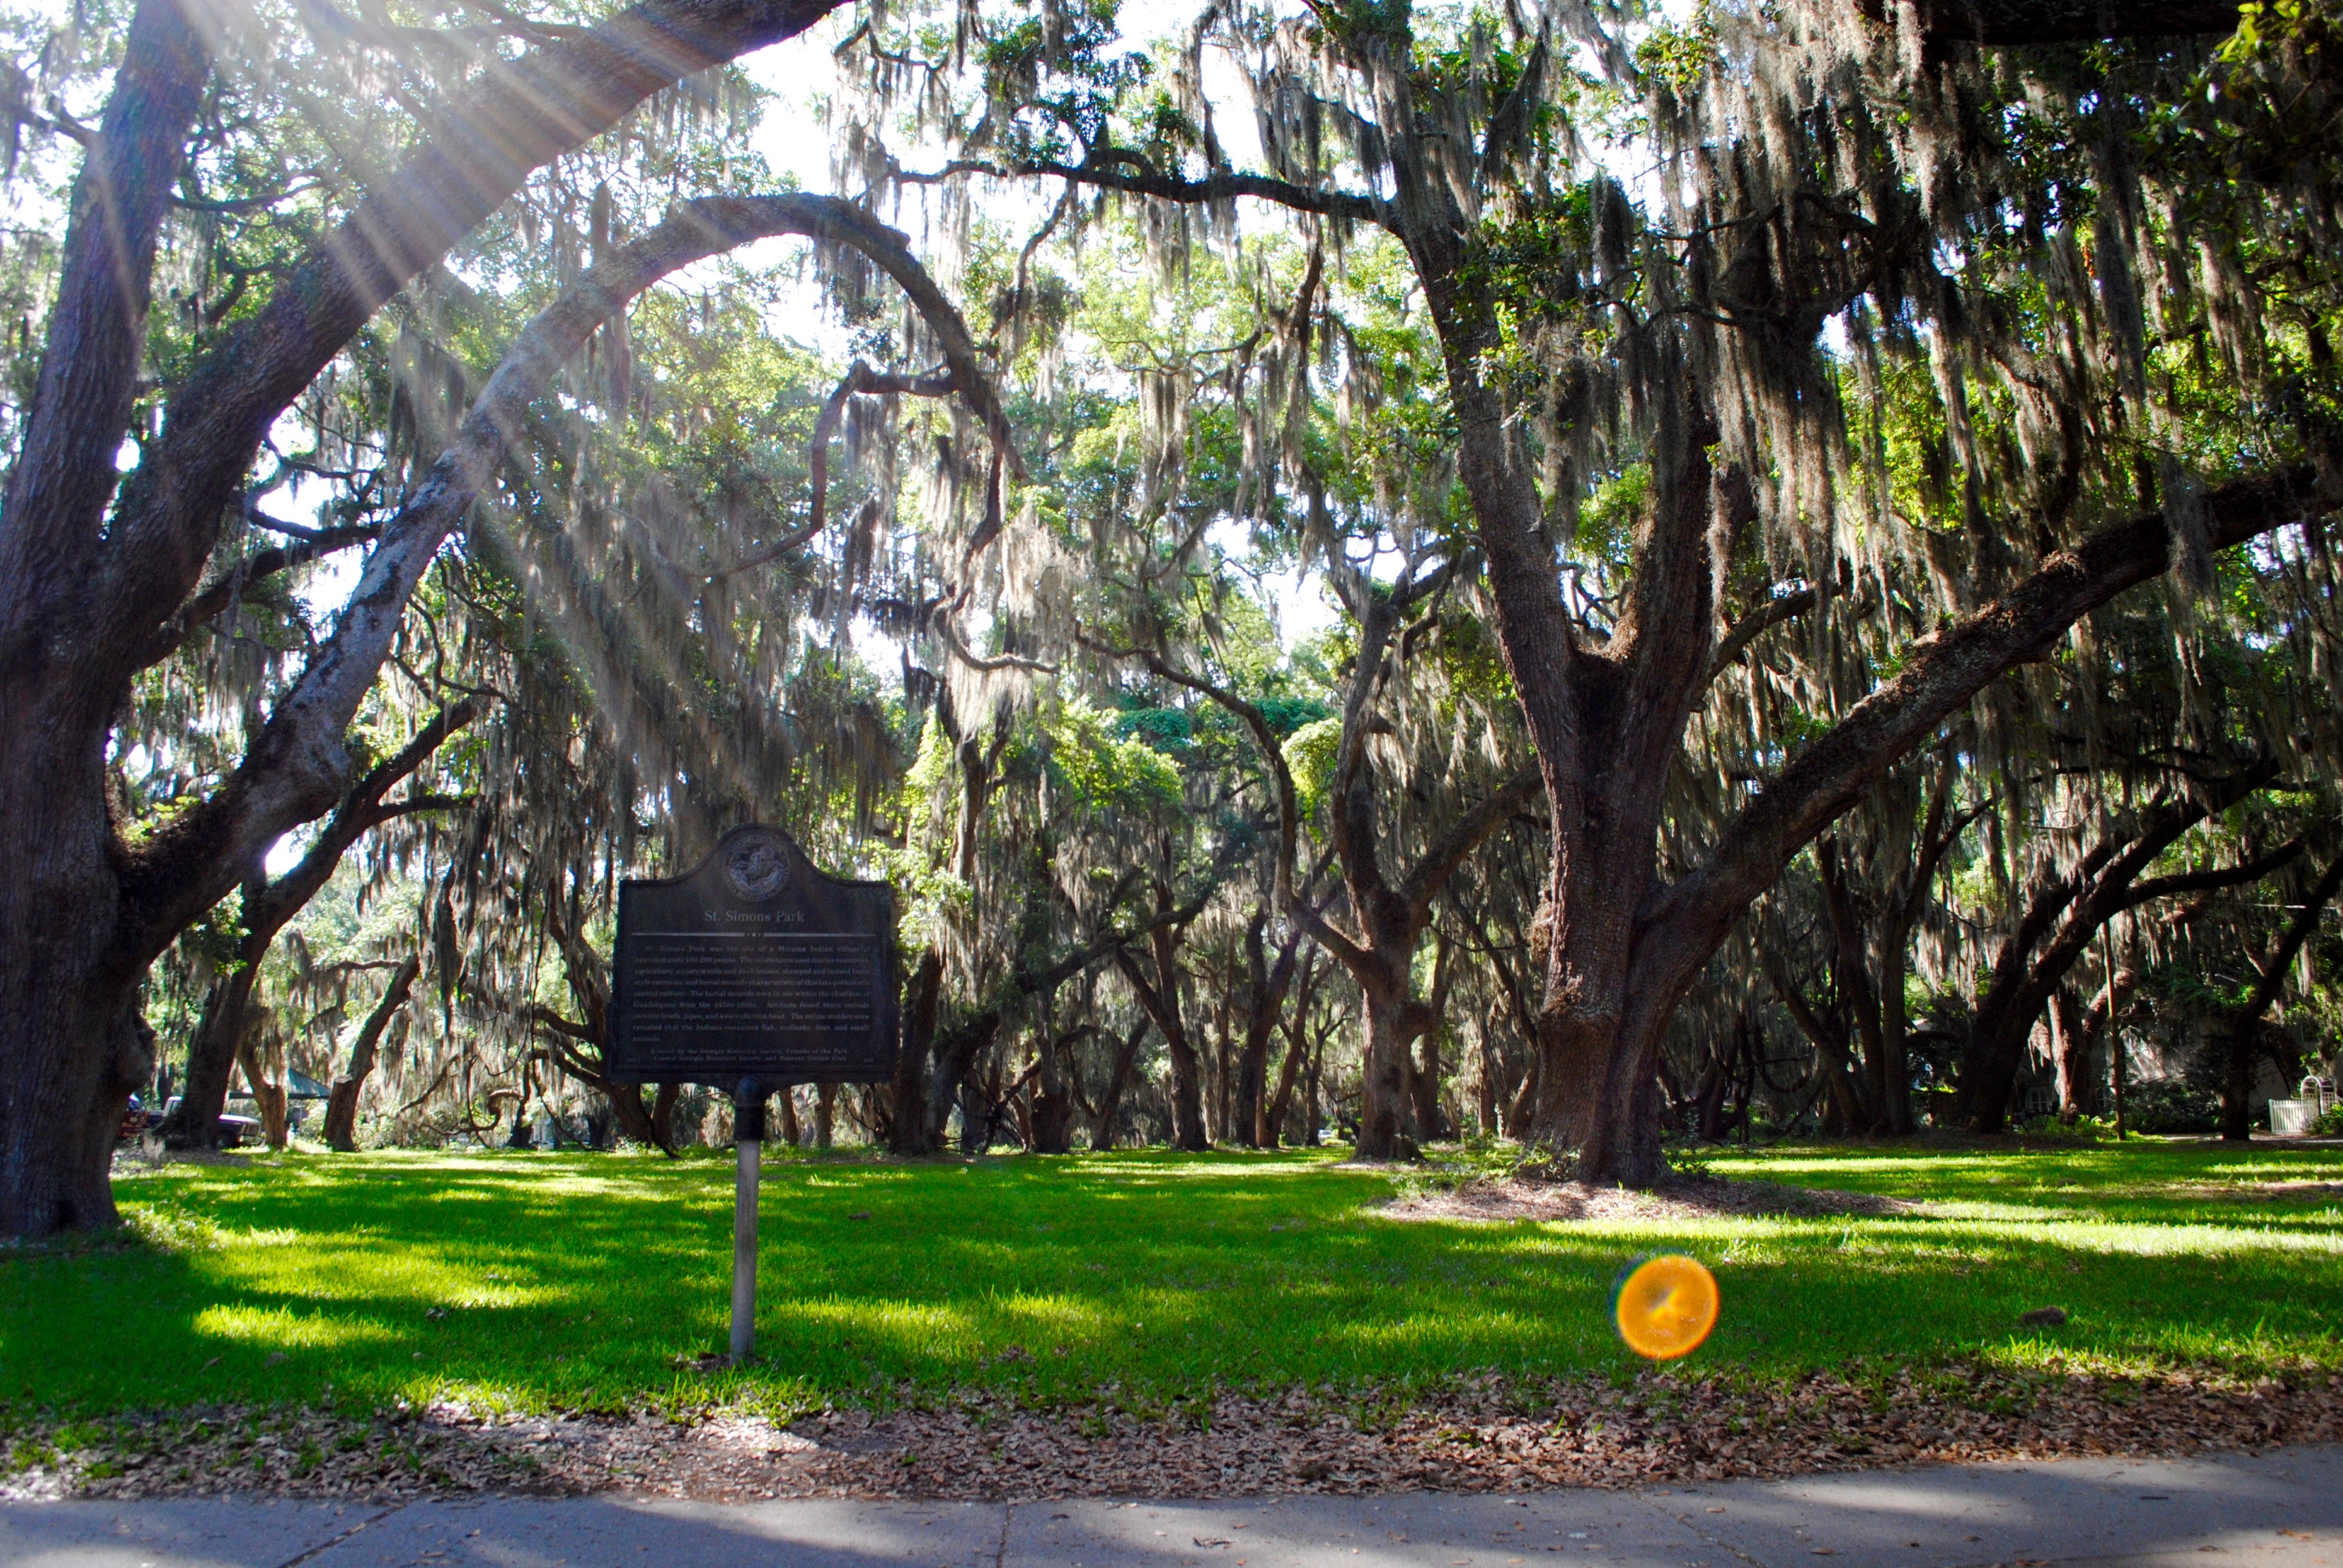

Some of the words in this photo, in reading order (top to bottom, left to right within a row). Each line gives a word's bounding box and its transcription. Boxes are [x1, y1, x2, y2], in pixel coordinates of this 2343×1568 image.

[704, 910, 721, 922] St.
[725, 910, 771, 922] Simons
[776, 910, 805, 923] Park
